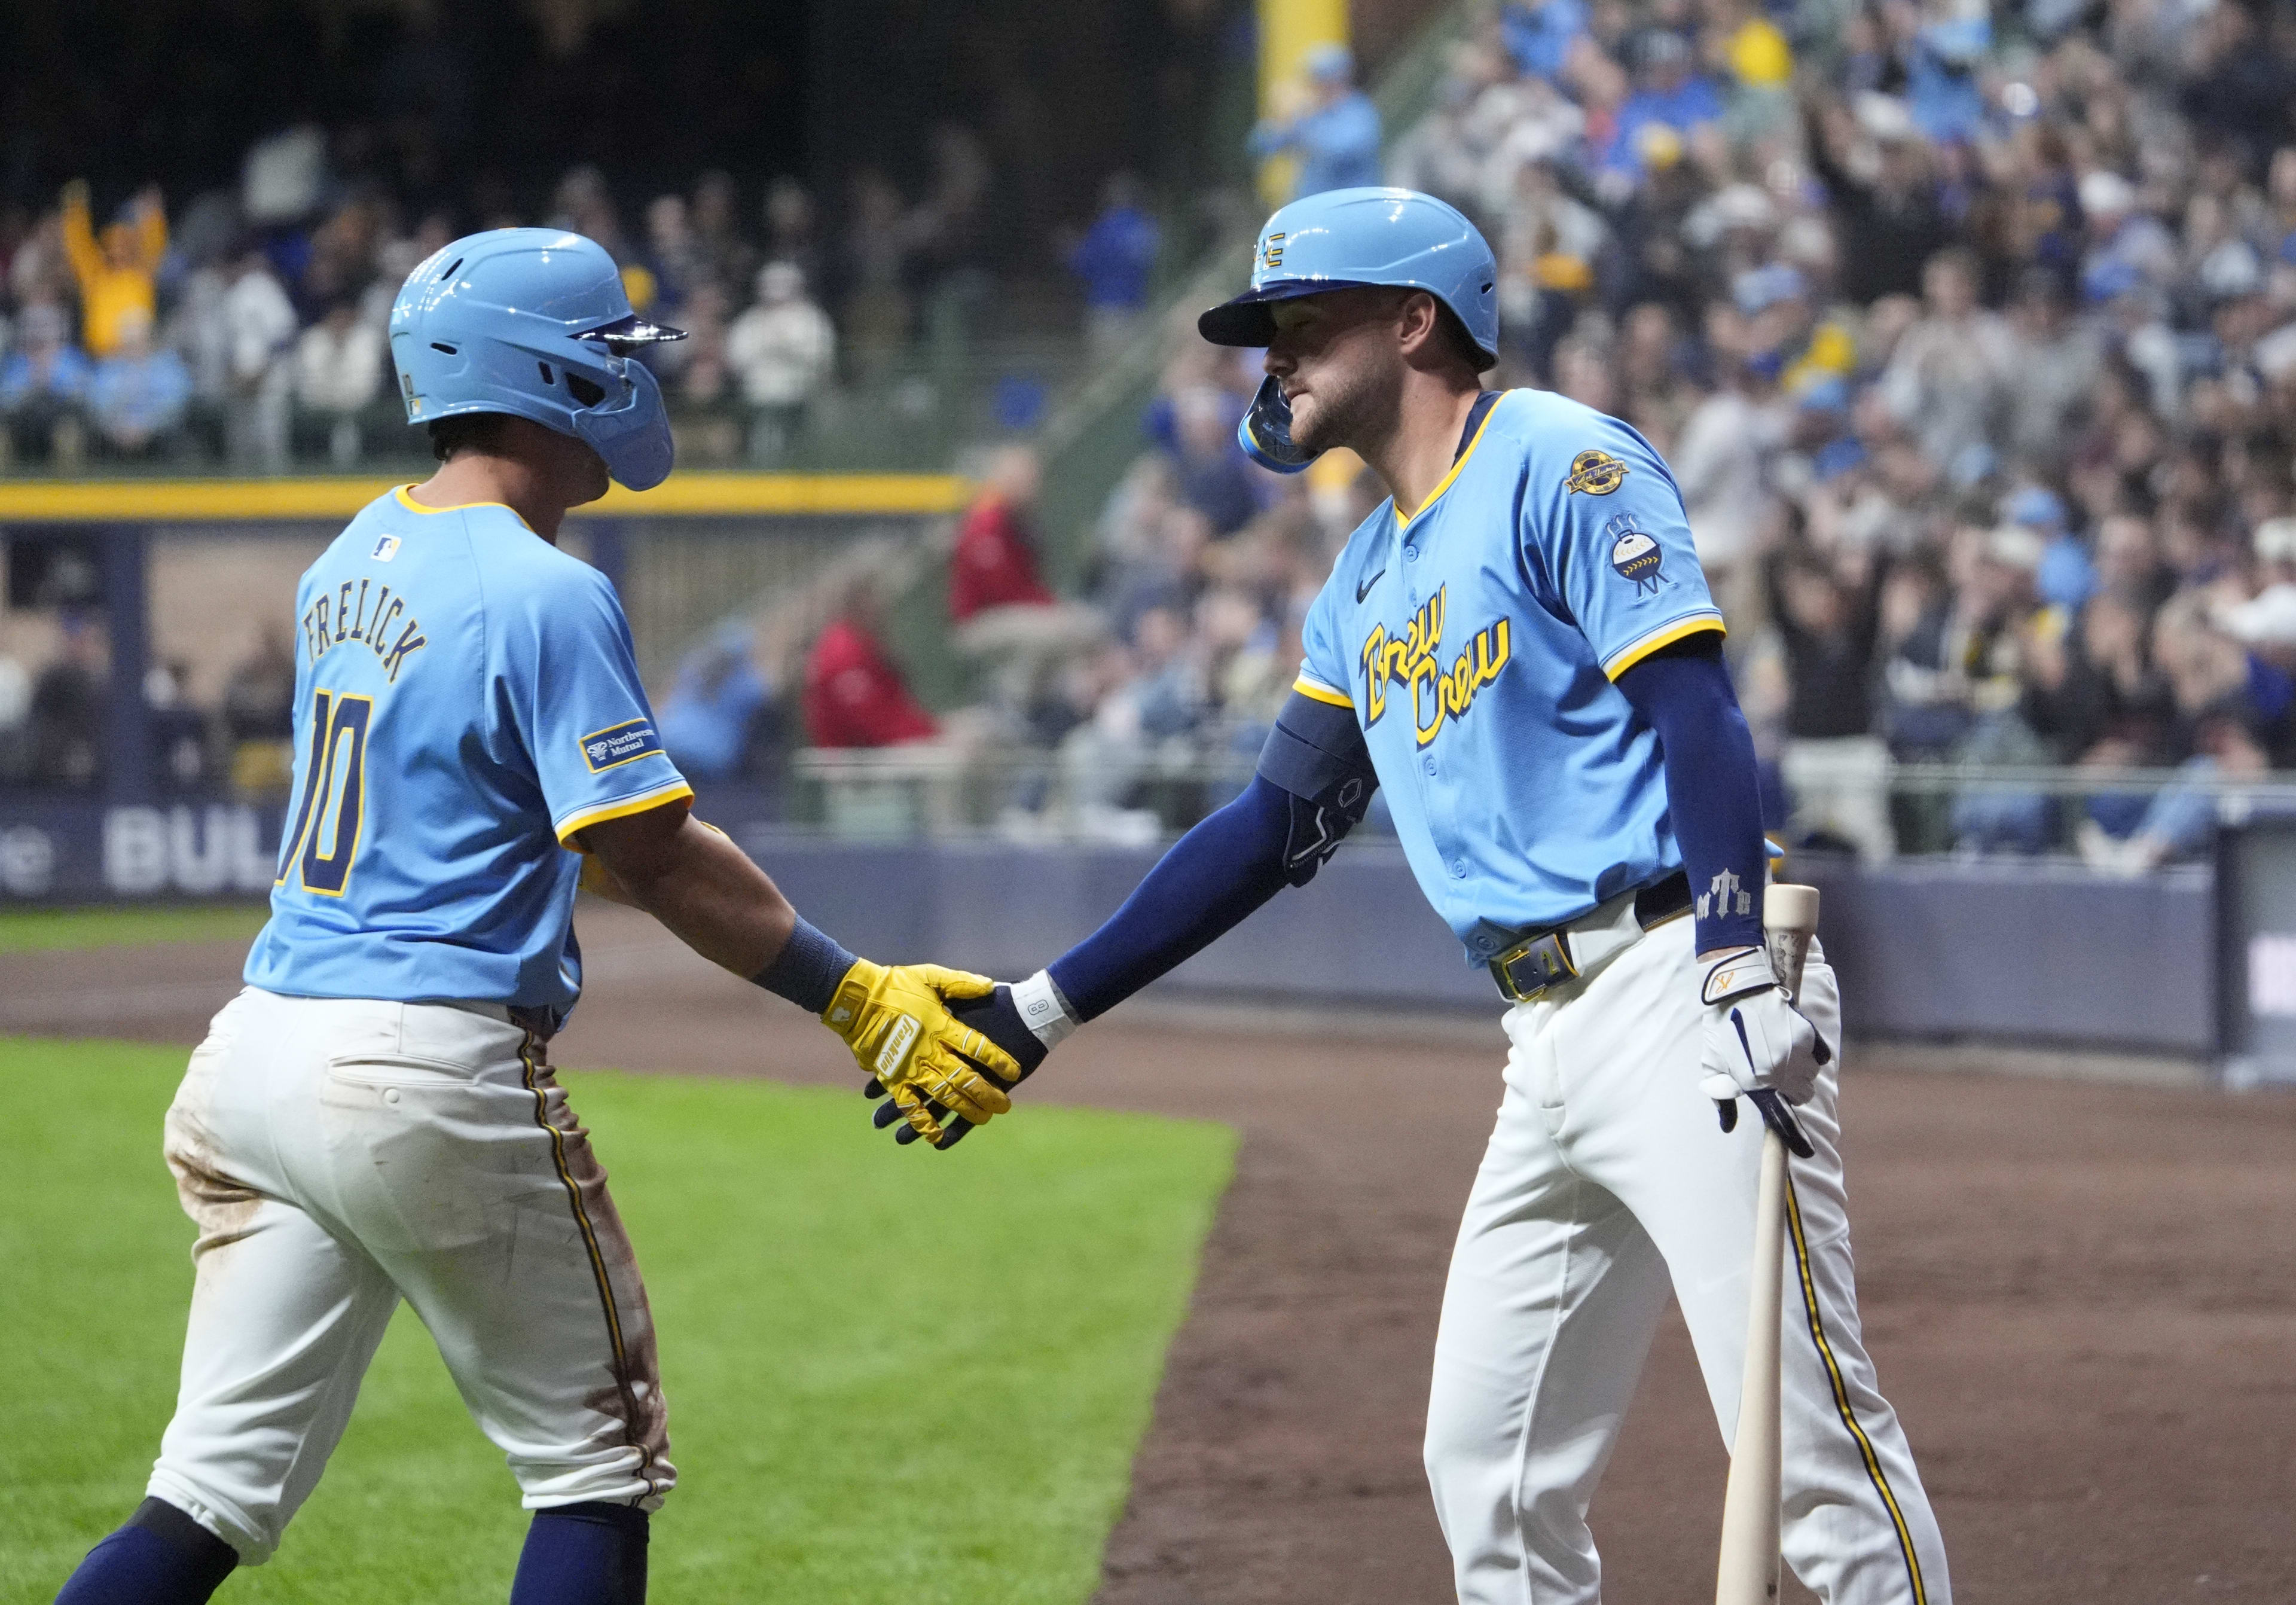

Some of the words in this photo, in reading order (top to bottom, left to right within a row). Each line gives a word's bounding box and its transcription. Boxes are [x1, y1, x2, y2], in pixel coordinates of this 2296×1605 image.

[302, 578, 428, 684] FRELICK
[1358, 581, 1446, 731] Brew
[1410, 616, 1512, 753] Crew
[274, 687, 374, 897] 10
[610, 739, 645, 756] Mutual
[102, 804, 284, 892] BUL
